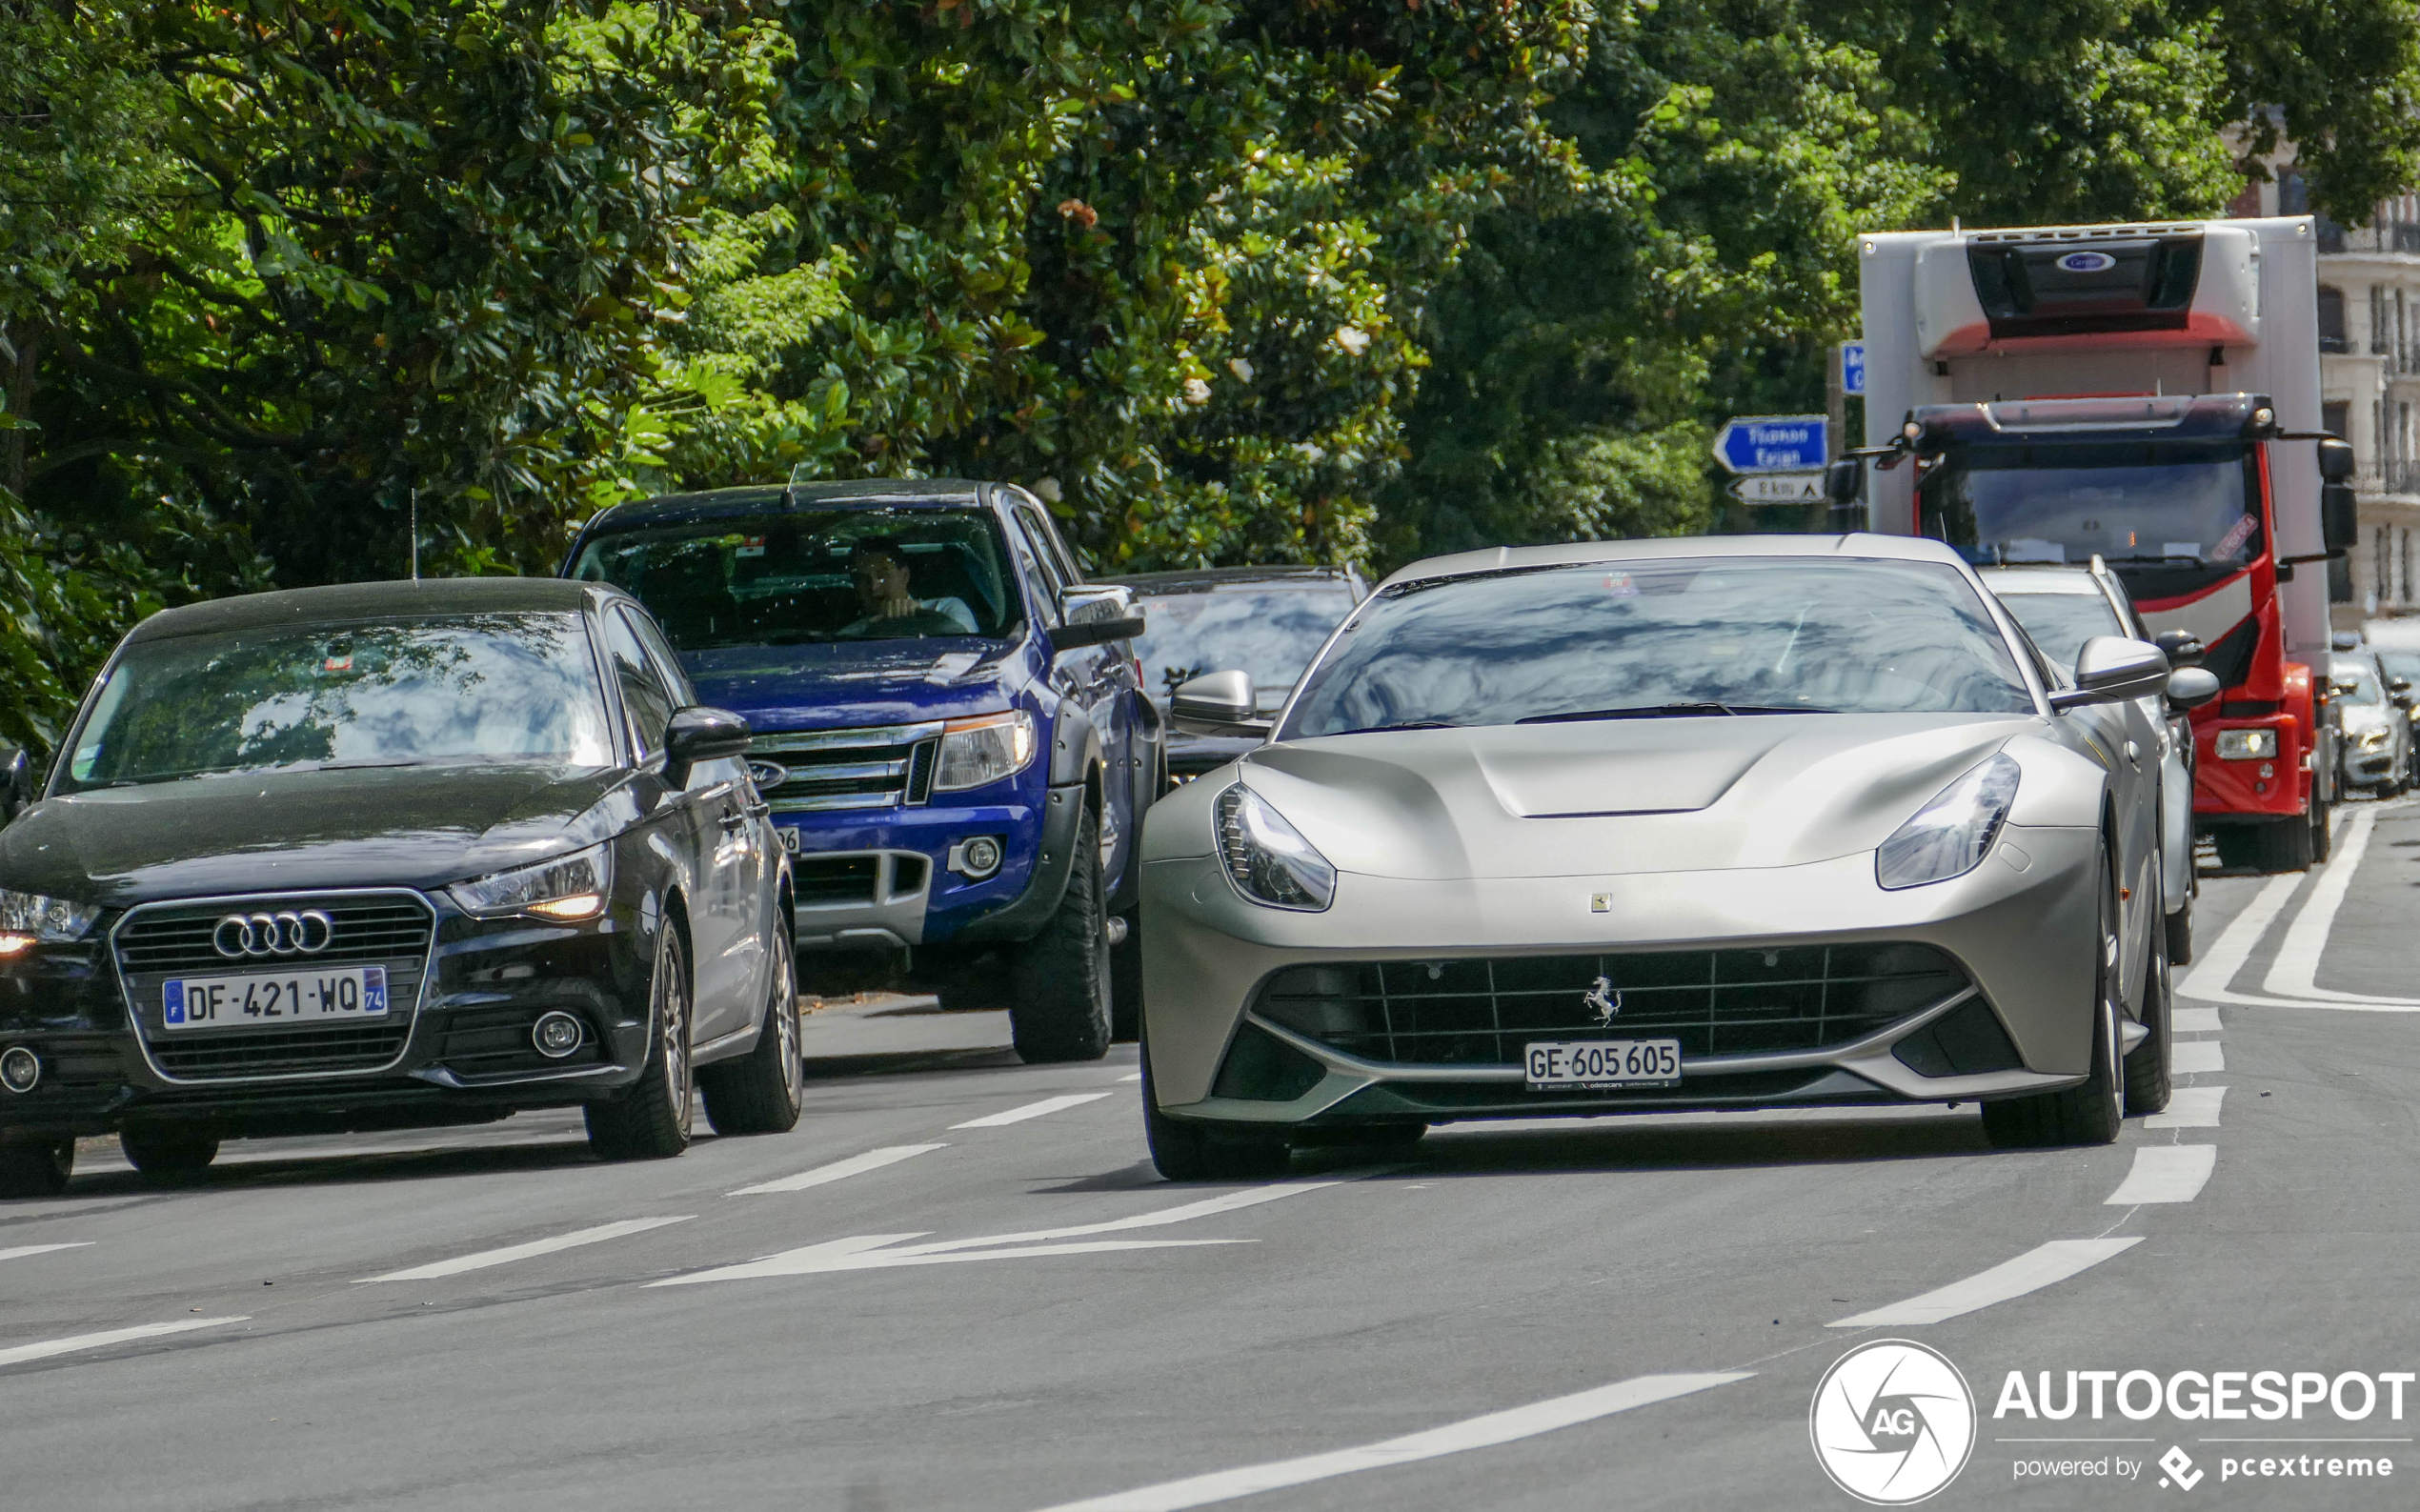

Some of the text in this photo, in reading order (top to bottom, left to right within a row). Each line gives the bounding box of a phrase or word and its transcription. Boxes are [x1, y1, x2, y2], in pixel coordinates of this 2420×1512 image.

[188, 978, 358, 1021] DF-421-WQ
[366, 992, 382, 1008] 74
[171, 1007, 178, 1017] F
